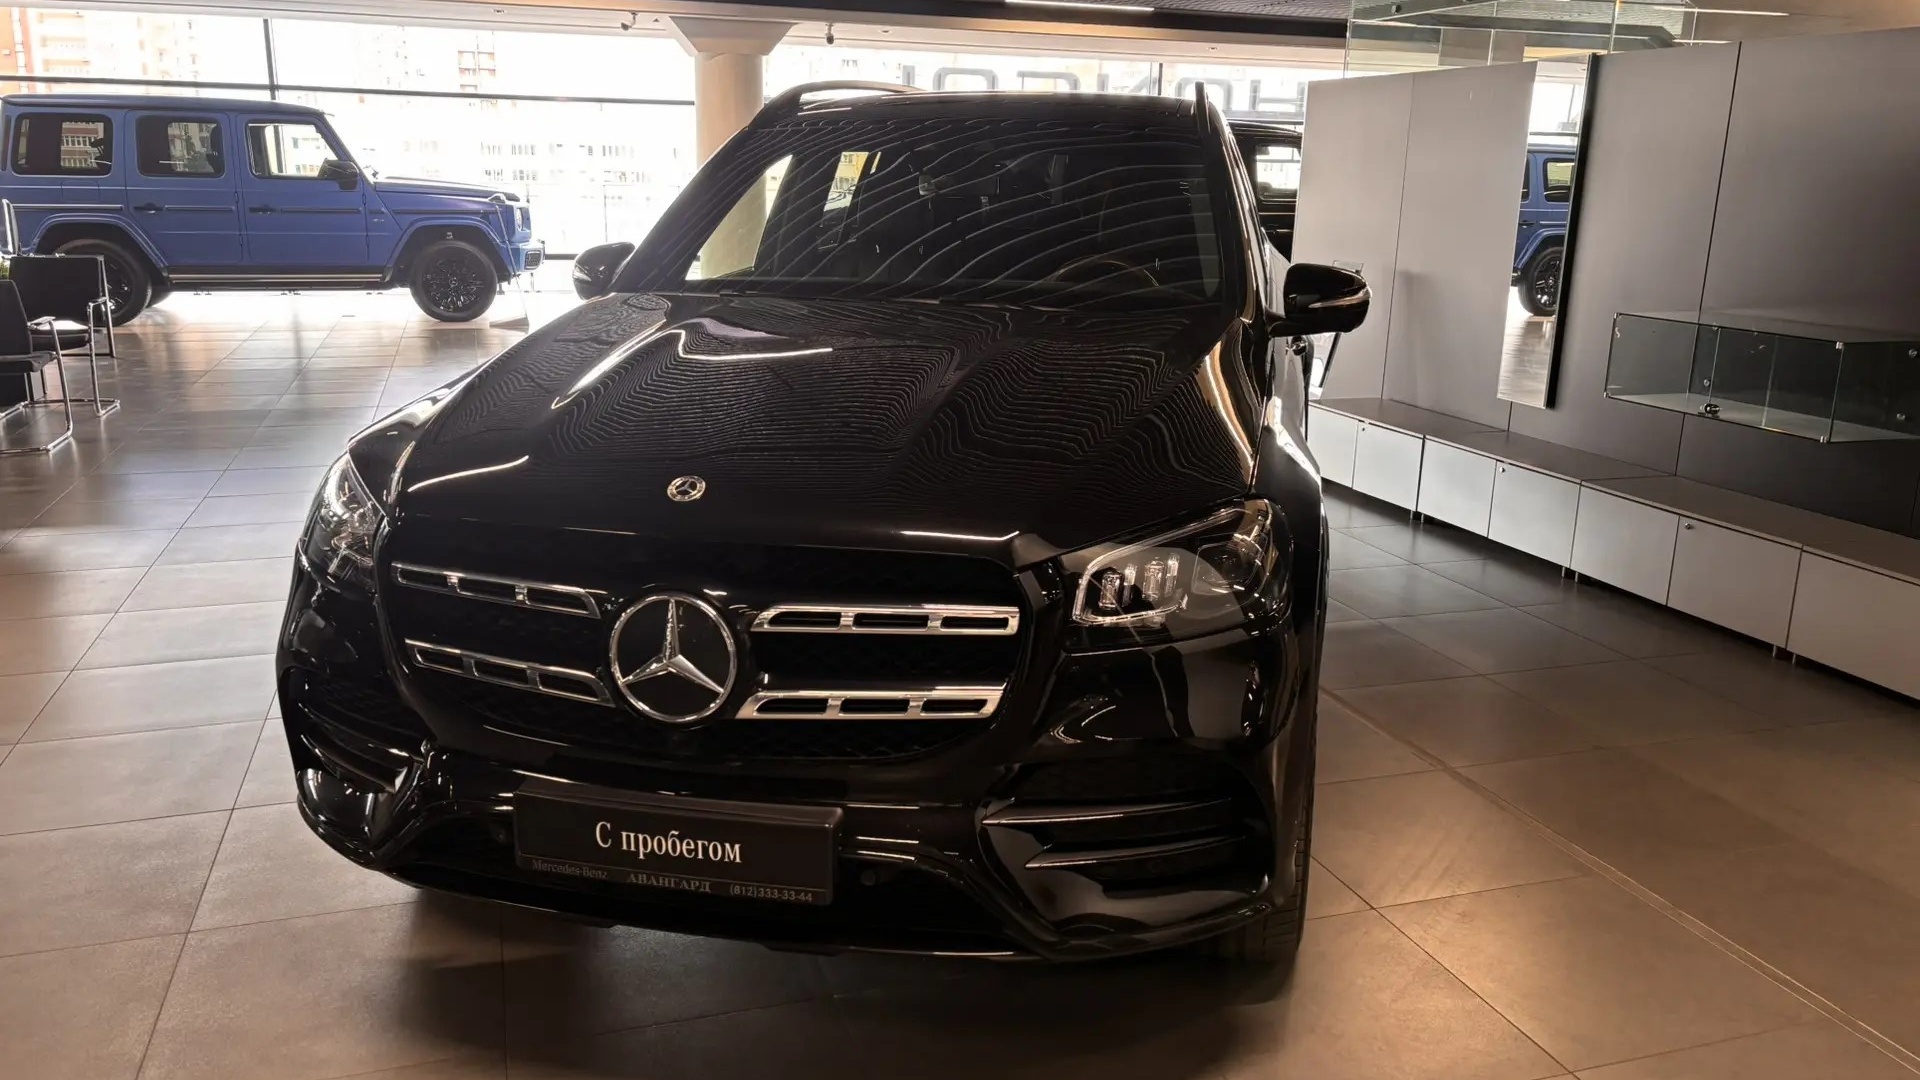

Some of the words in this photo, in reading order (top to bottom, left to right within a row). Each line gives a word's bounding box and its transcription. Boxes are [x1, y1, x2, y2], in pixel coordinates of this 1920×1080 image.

[595, 821, 612, 848] С
[621, 830, 743, 863] пробегом
[532, 859, 608, 880] Mercedes-Benz
[627, 872, 712, 894] АВАНГАРД
[729, 883, 813, 903] (812)333-33-44
